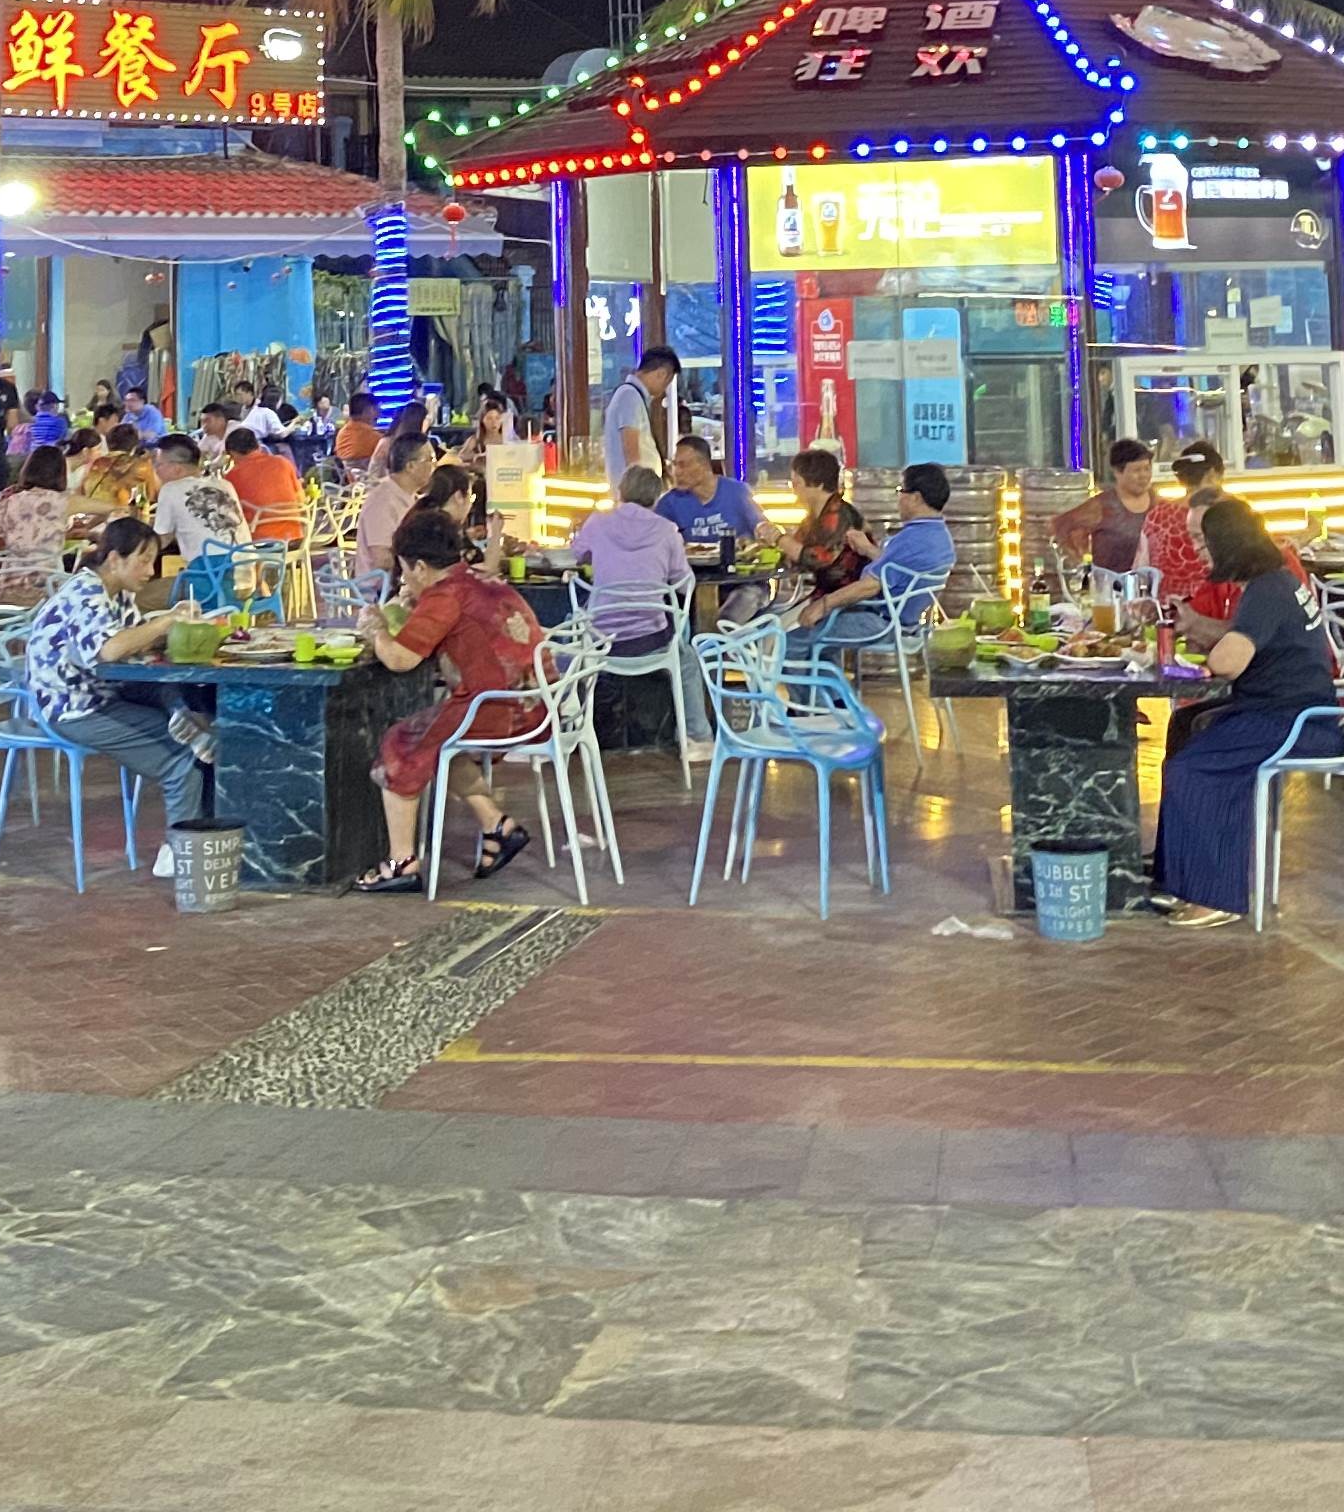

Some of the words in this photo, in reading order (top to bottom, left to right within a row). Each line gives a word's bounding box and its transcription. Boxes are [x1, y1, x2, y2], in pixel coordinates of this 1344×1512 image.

[812, 0, 1000, 37] 啤酒
[794, 44, 988, 81] 狂欢
[250, 92, 317, 119] 9号店
[1069, 884, 1093, 903] ST
